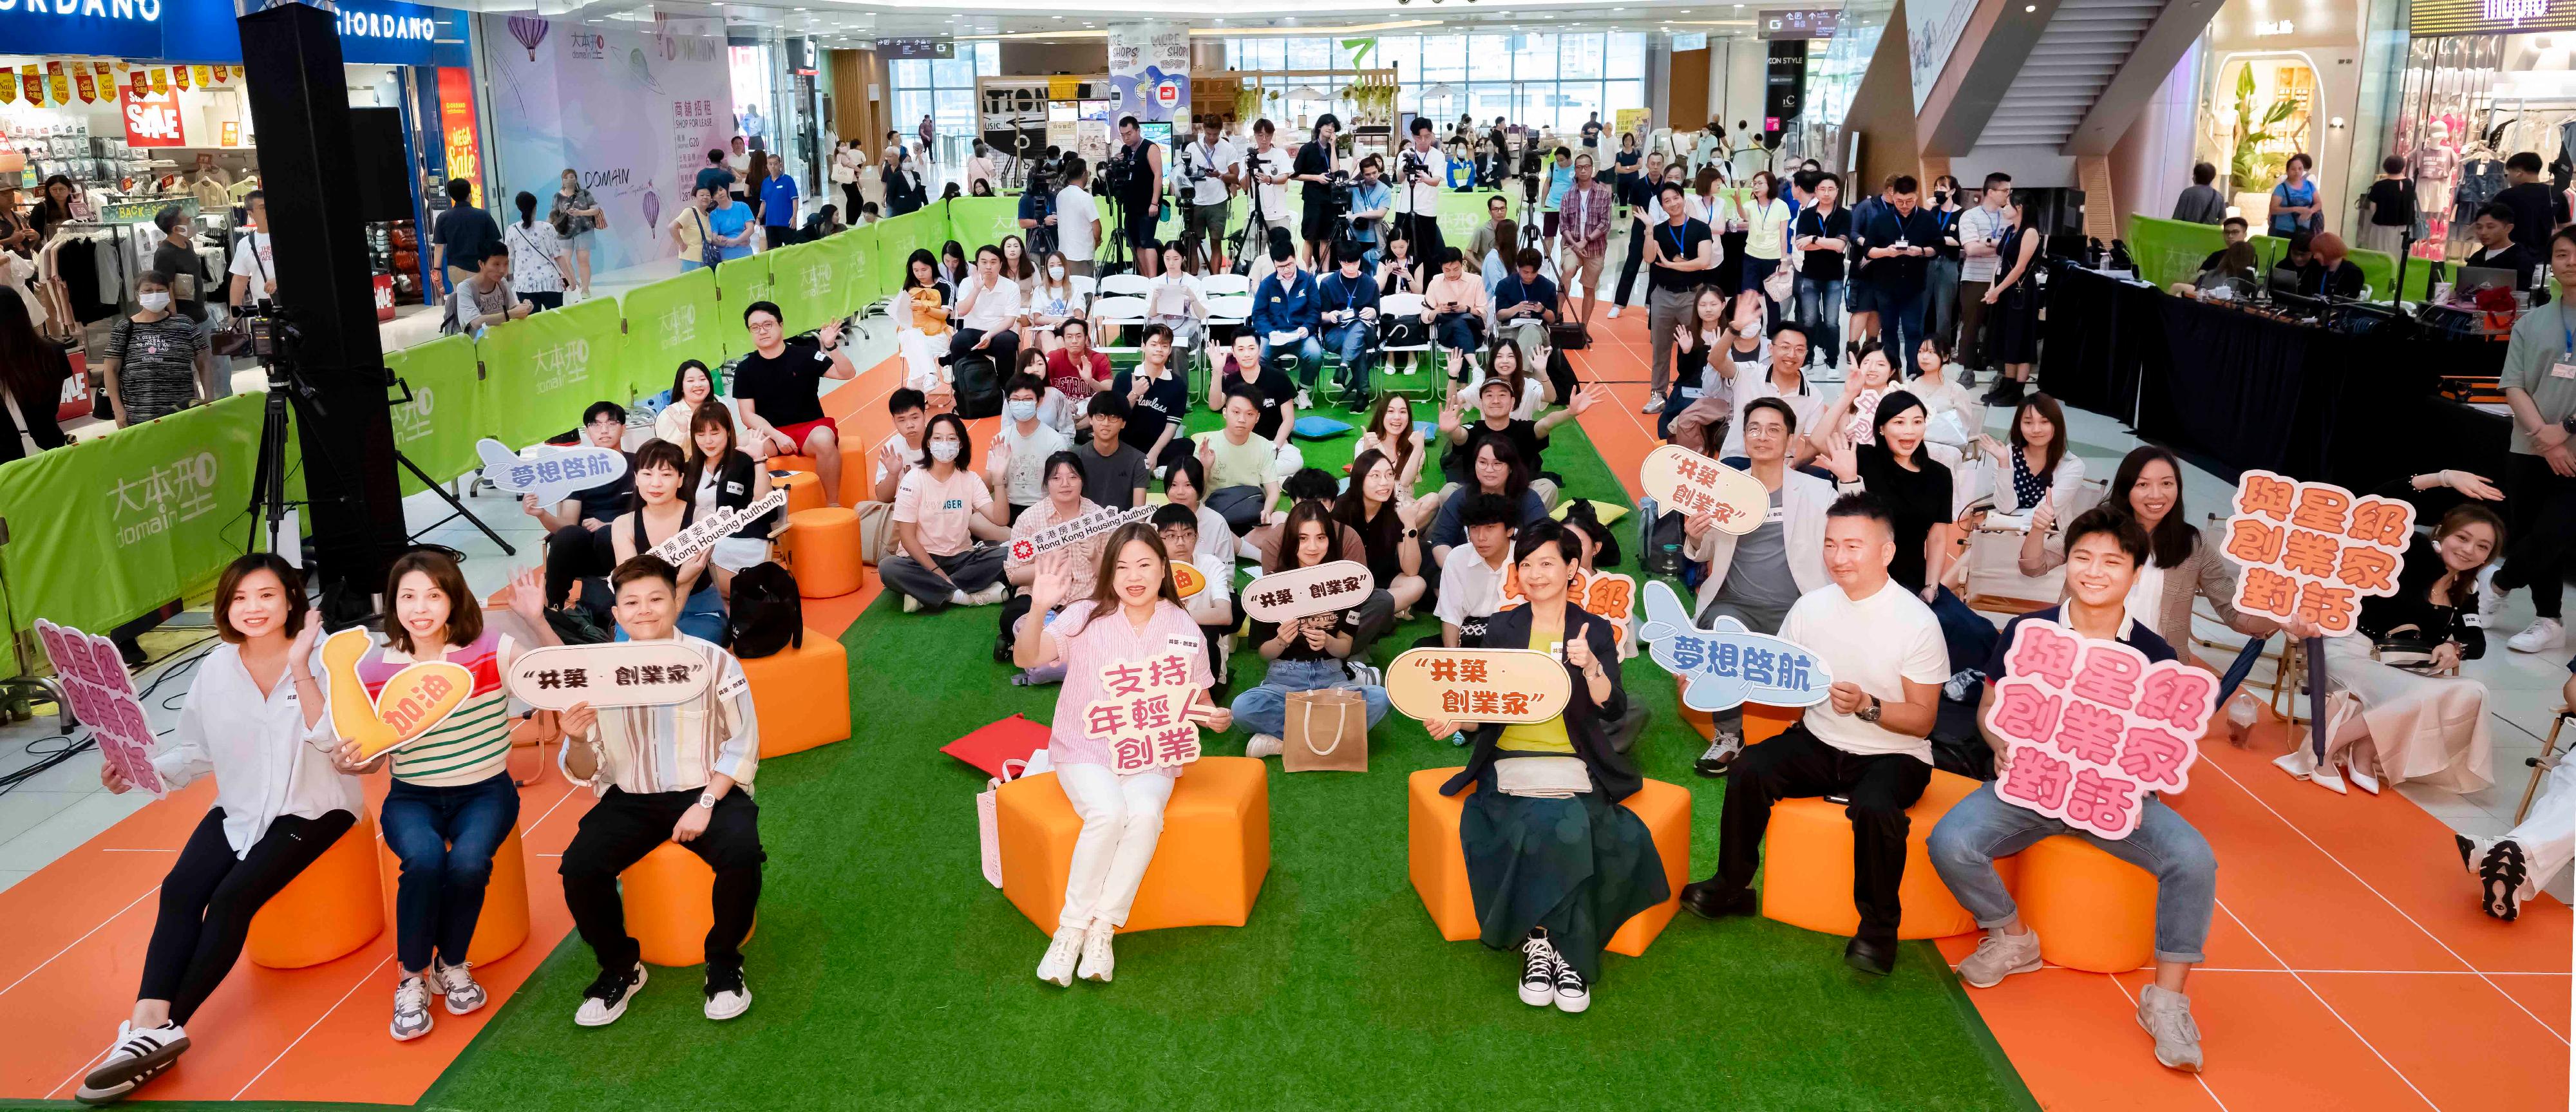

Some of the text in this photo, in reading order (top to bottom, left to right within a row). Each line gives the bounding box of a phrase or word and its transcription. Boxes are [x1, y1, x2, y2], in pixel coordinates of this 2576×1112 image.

[453, 127, 472, 147] MEGA
[676, 118, 712, 128] SHOP FOR LEASE
[689, 137, 699, 147] G20
[448, 146, 476, 179] Sale
[585, 167, 630, 189] DOMAIN
[118, 205, 144, 219] BACK
[1053, 375, 1094, 396] DETROI
[115, 504, 178, 549] domain
[697, 518, 740, 547] Housing
[741, 492, 784, 523] Authority
[1035, 509, 1117, 544] 香港房屋委員會
[1037, 504, 1160, 552] Hong Kong Housing Authority
[2240, 475, 2409, 547] 與星級
[2228, 518, 2397, 591] 創業家
[2240, 567, 2356, 632] 對話
[1104, 655, 1188, 697] 支持
[2014, 625, 2210, 731] 與星級
[383, 674, 453, 737] 加油
[1086, 689, 1213, 740] 年輕人
[1113, 726, 1197, 770] 創業
[1993, 682, 2189, 786] 創業家
[2003, 746, 2137, 833] 對話
